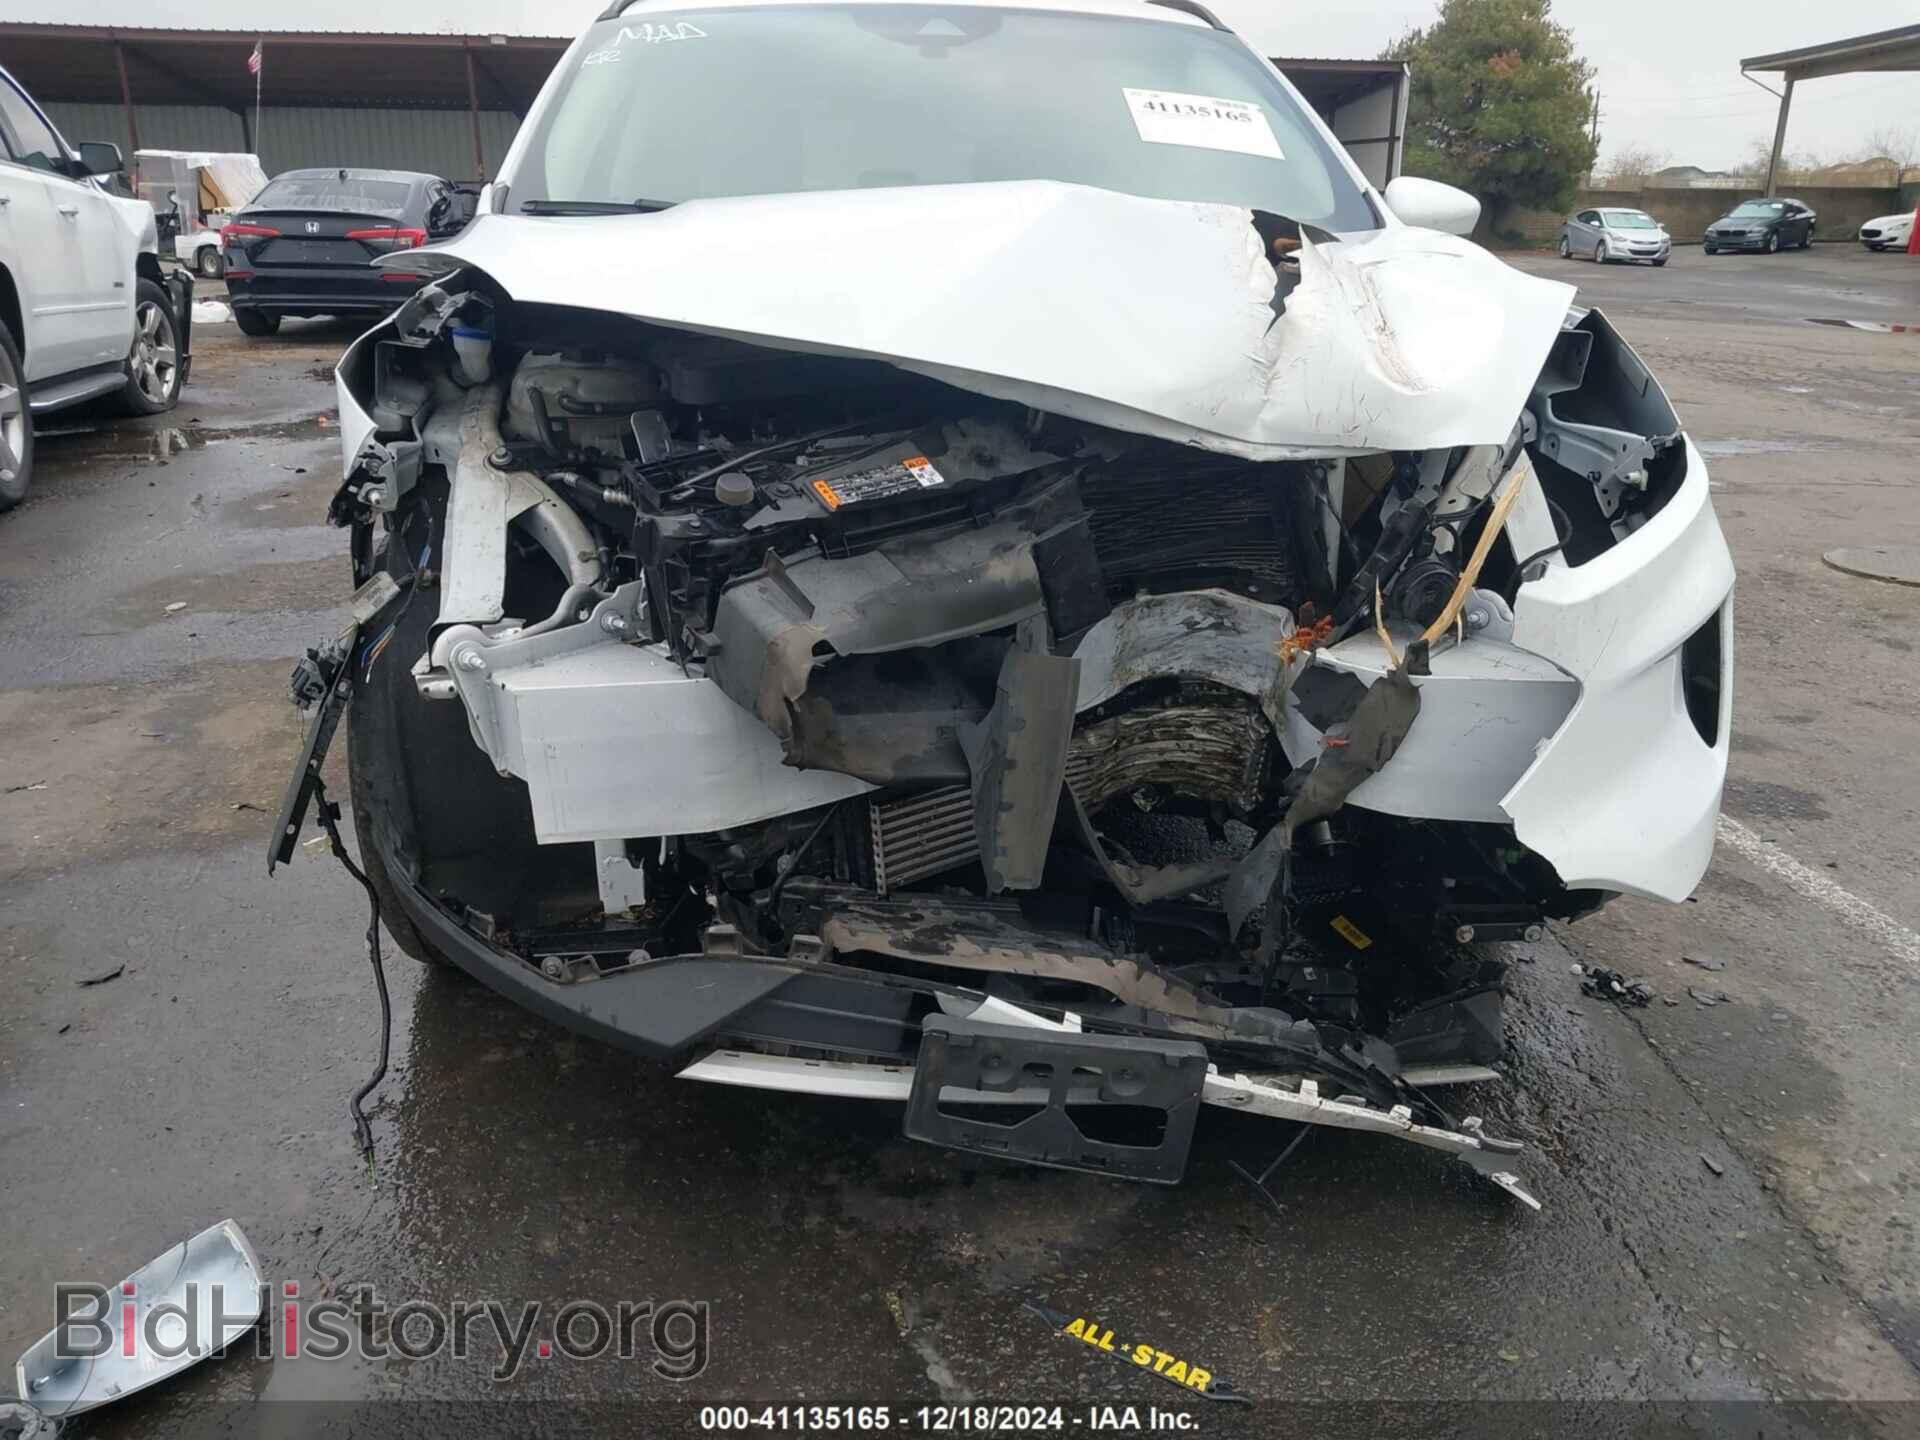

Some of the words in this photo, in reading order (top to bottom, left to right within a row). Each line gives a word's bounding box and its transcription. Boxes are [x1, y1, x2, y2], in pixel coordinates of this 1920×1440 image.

[1143, 101, 1253, 123] 41135165
[1063, 1317, 1115, 1352] ALL
[1131, 1344, 1213, 1393] STAR
